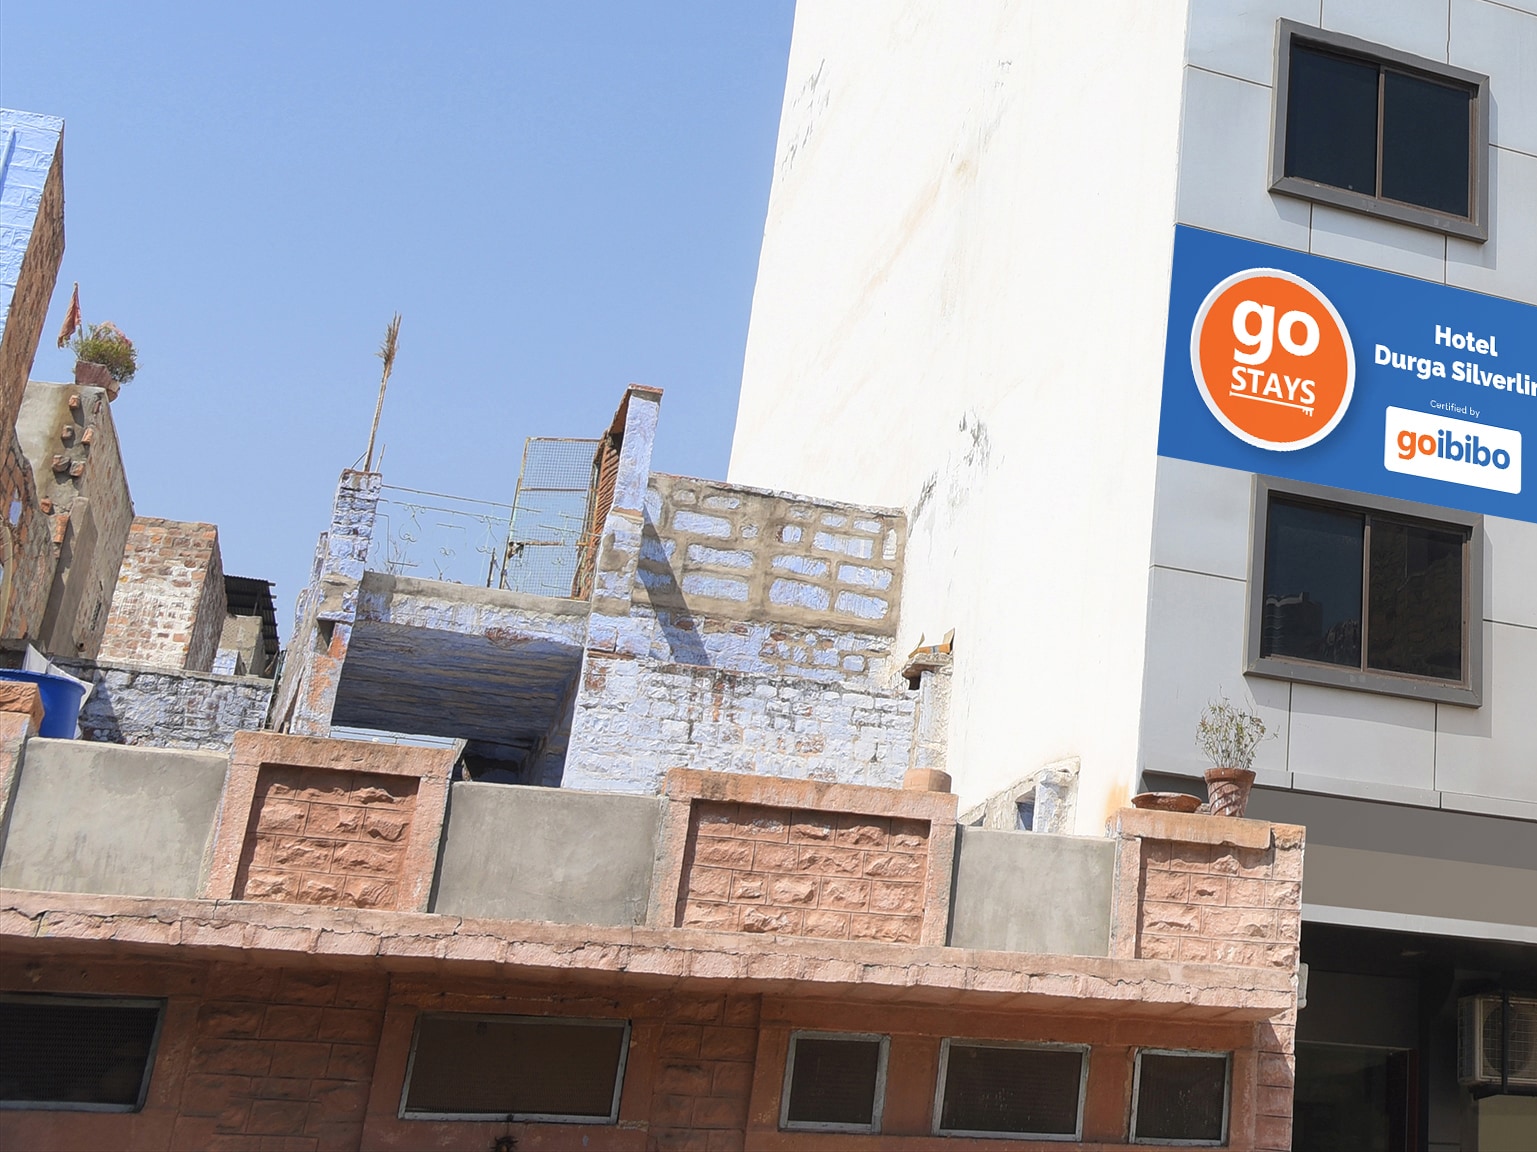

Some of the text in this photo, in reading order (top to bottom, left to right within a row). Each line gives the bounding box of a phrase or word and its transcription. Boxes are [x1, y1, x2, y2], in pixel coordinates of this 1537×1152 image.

[1232, 300, 1320, 366] go
[1434, 324, 1498, 357] Hotel
[1374, 344, 1446, 380] Durga
[1231, 366, 1316, 405] STAYS
[1429, 399, 1481, 418] Certified by
[1397, 429, 1511, 470] goibibo
